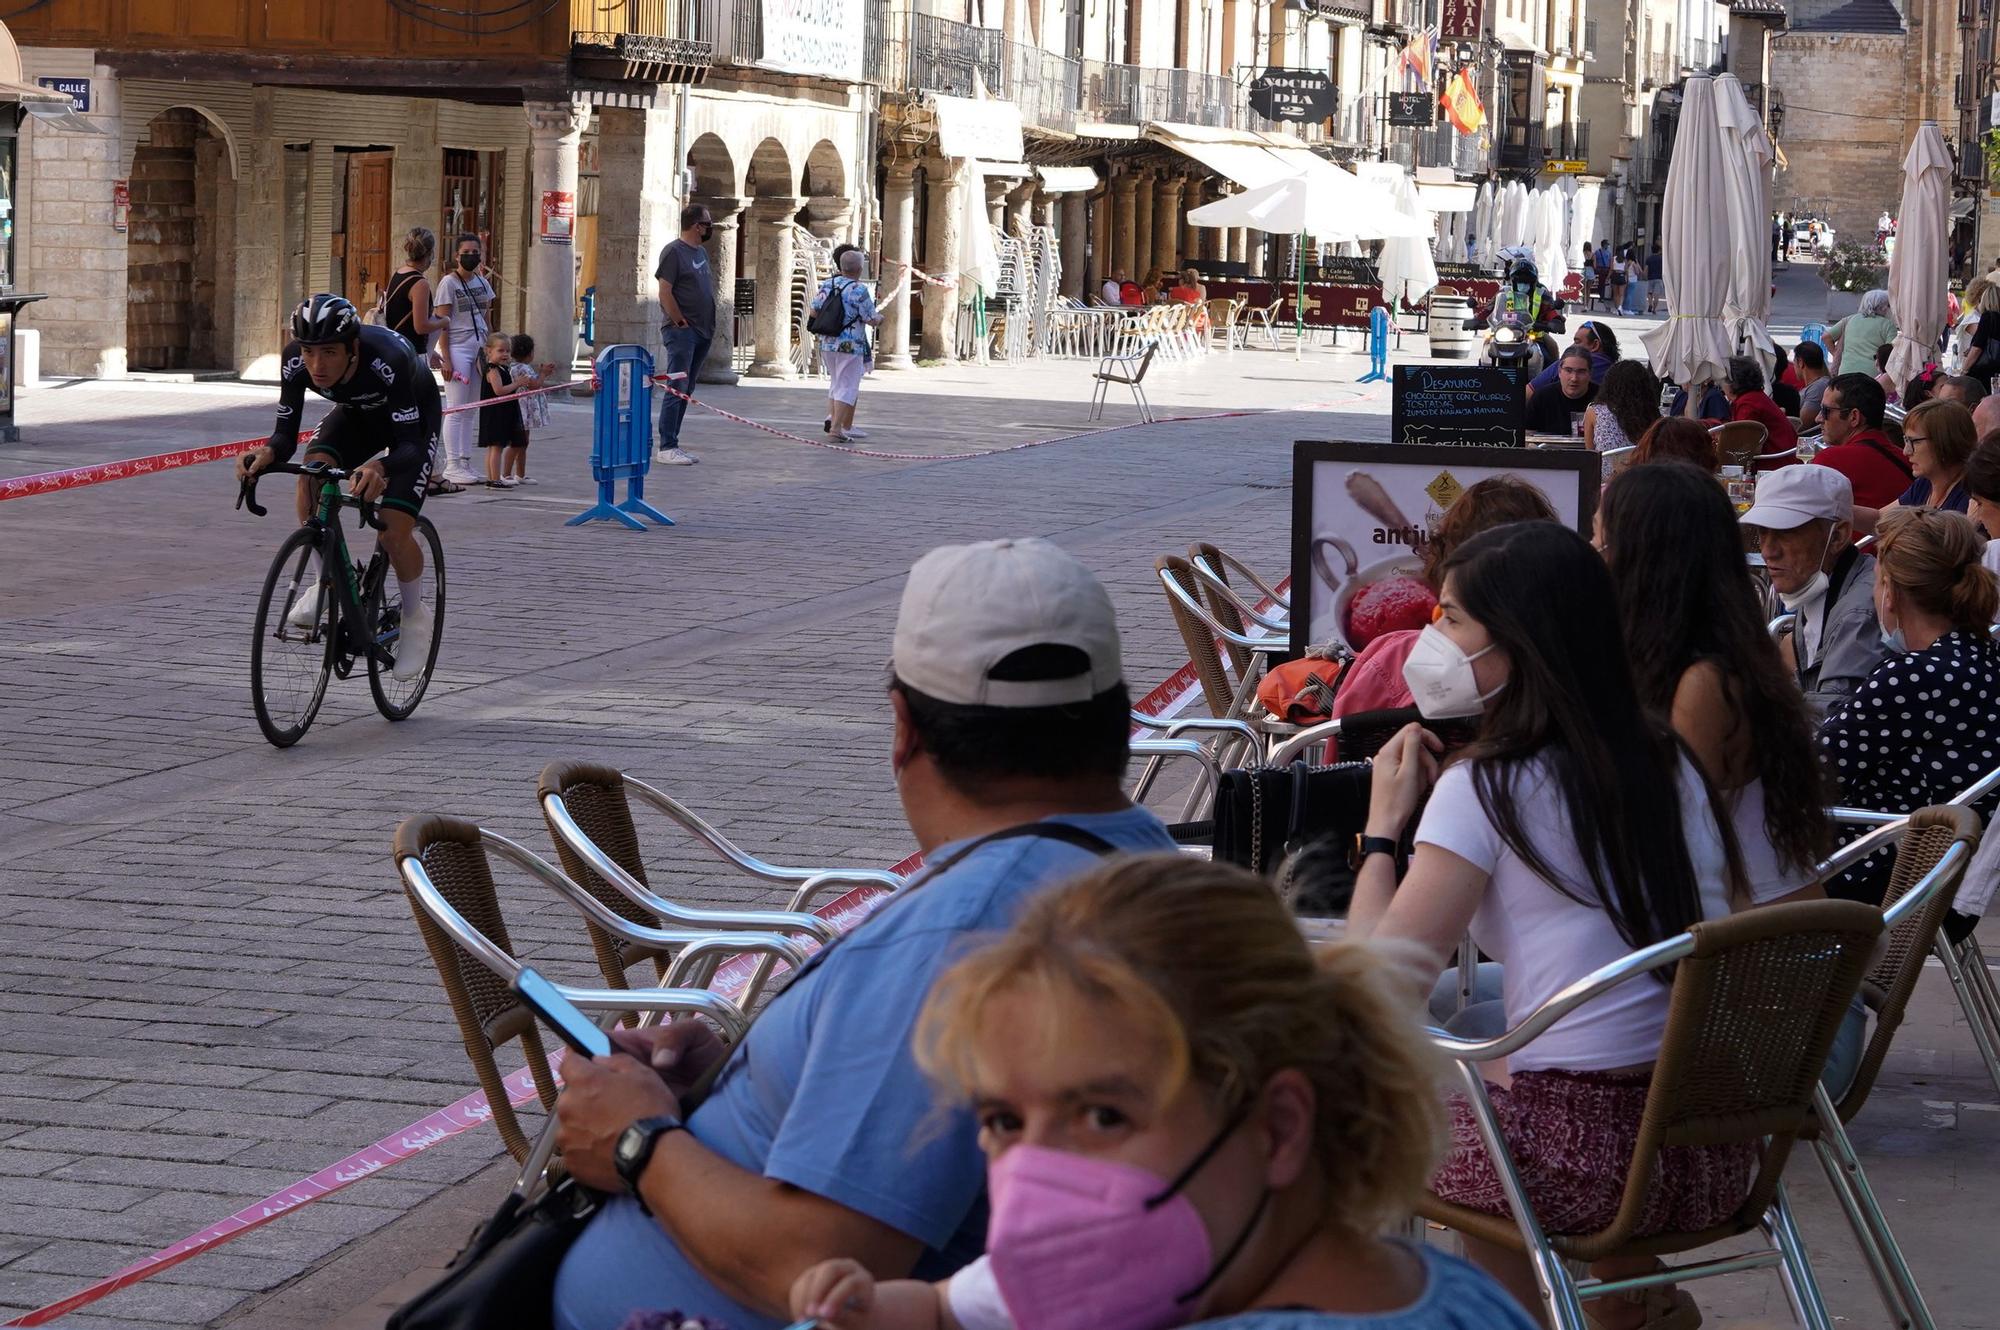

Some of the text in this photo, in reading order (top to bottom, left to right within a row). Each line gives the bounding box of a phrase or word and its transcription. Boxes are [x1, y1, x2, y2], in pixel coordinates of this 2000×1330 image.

[59, 83, 86, 93] CALLE
[1263, 77, 1326, 90] NOCHE
[1421, 371, 1482, 390] DESAYUNOS
[1405, 391, 1453, 401] CHOCOLATE
[1455, 393, 1472, 401] CON
[1406, 400, 1455, 409] TOSTADAS
[413, 462, 431, 498] AVC
